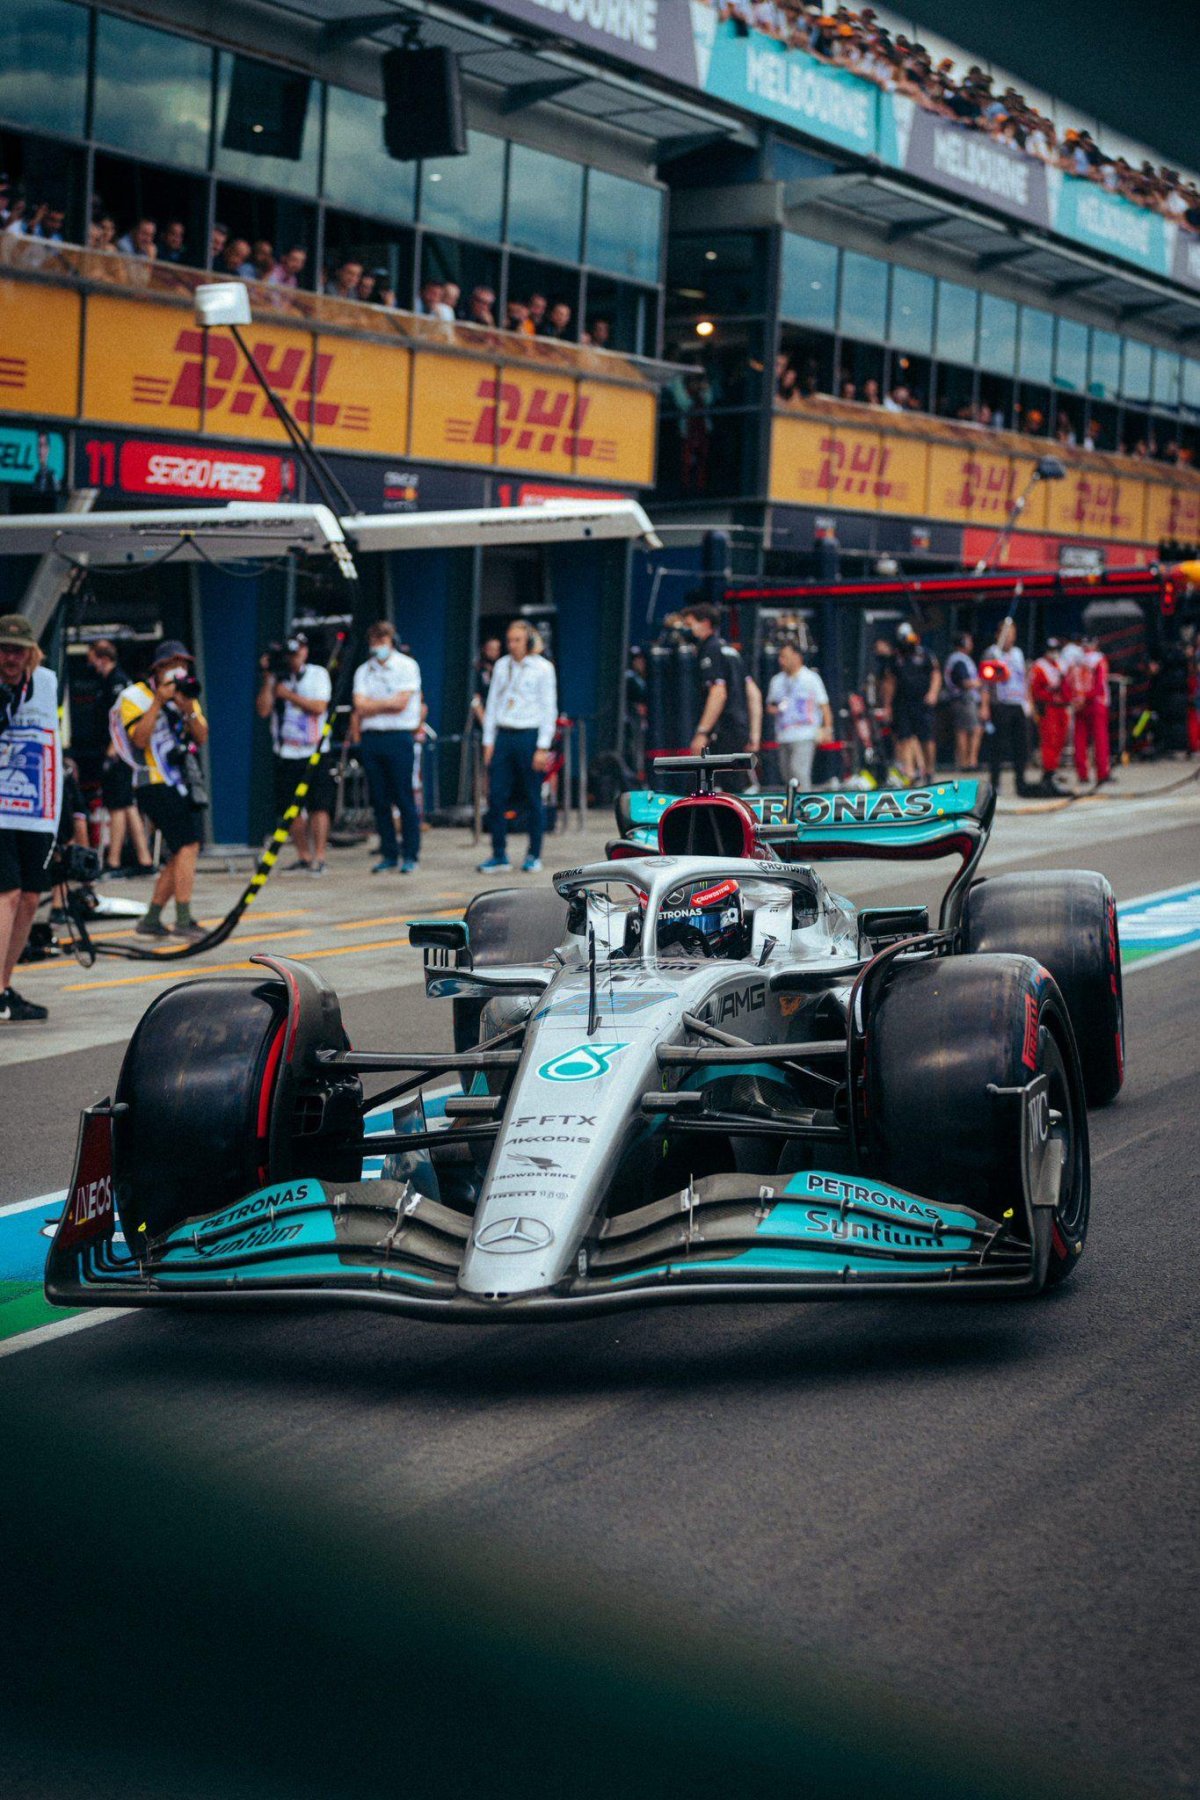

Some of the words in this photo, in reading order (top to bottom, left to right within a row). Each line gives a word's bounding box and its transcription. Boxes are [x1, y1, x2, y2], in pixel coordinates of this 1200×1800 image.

[747, 46, 868, 140] MELBOURNE
[168, 329, 341, 427] DHL
[472, 379, 595, 458] DHL
[85, 438, 116, 488] 11
[146, 454, 210, 487] SERGIO
[209, 460, 265, 492] PEREZ
[817, 437, 894, 498] DHL
[658, 907, 703, 921] ETRONAS
[720, 982, 766, 1024] AMG
[504, 1135, 592, 1146] AKKODIS
[538, 1115, 599, 1127] FTX
[75, 1175, 112, 1226] INEOS
[201, 1184, 309, 1230] PETRONAS
[805, 1173, 940, 1220] PETRONAS
[805, 1209, 944, 1248] Syntium
